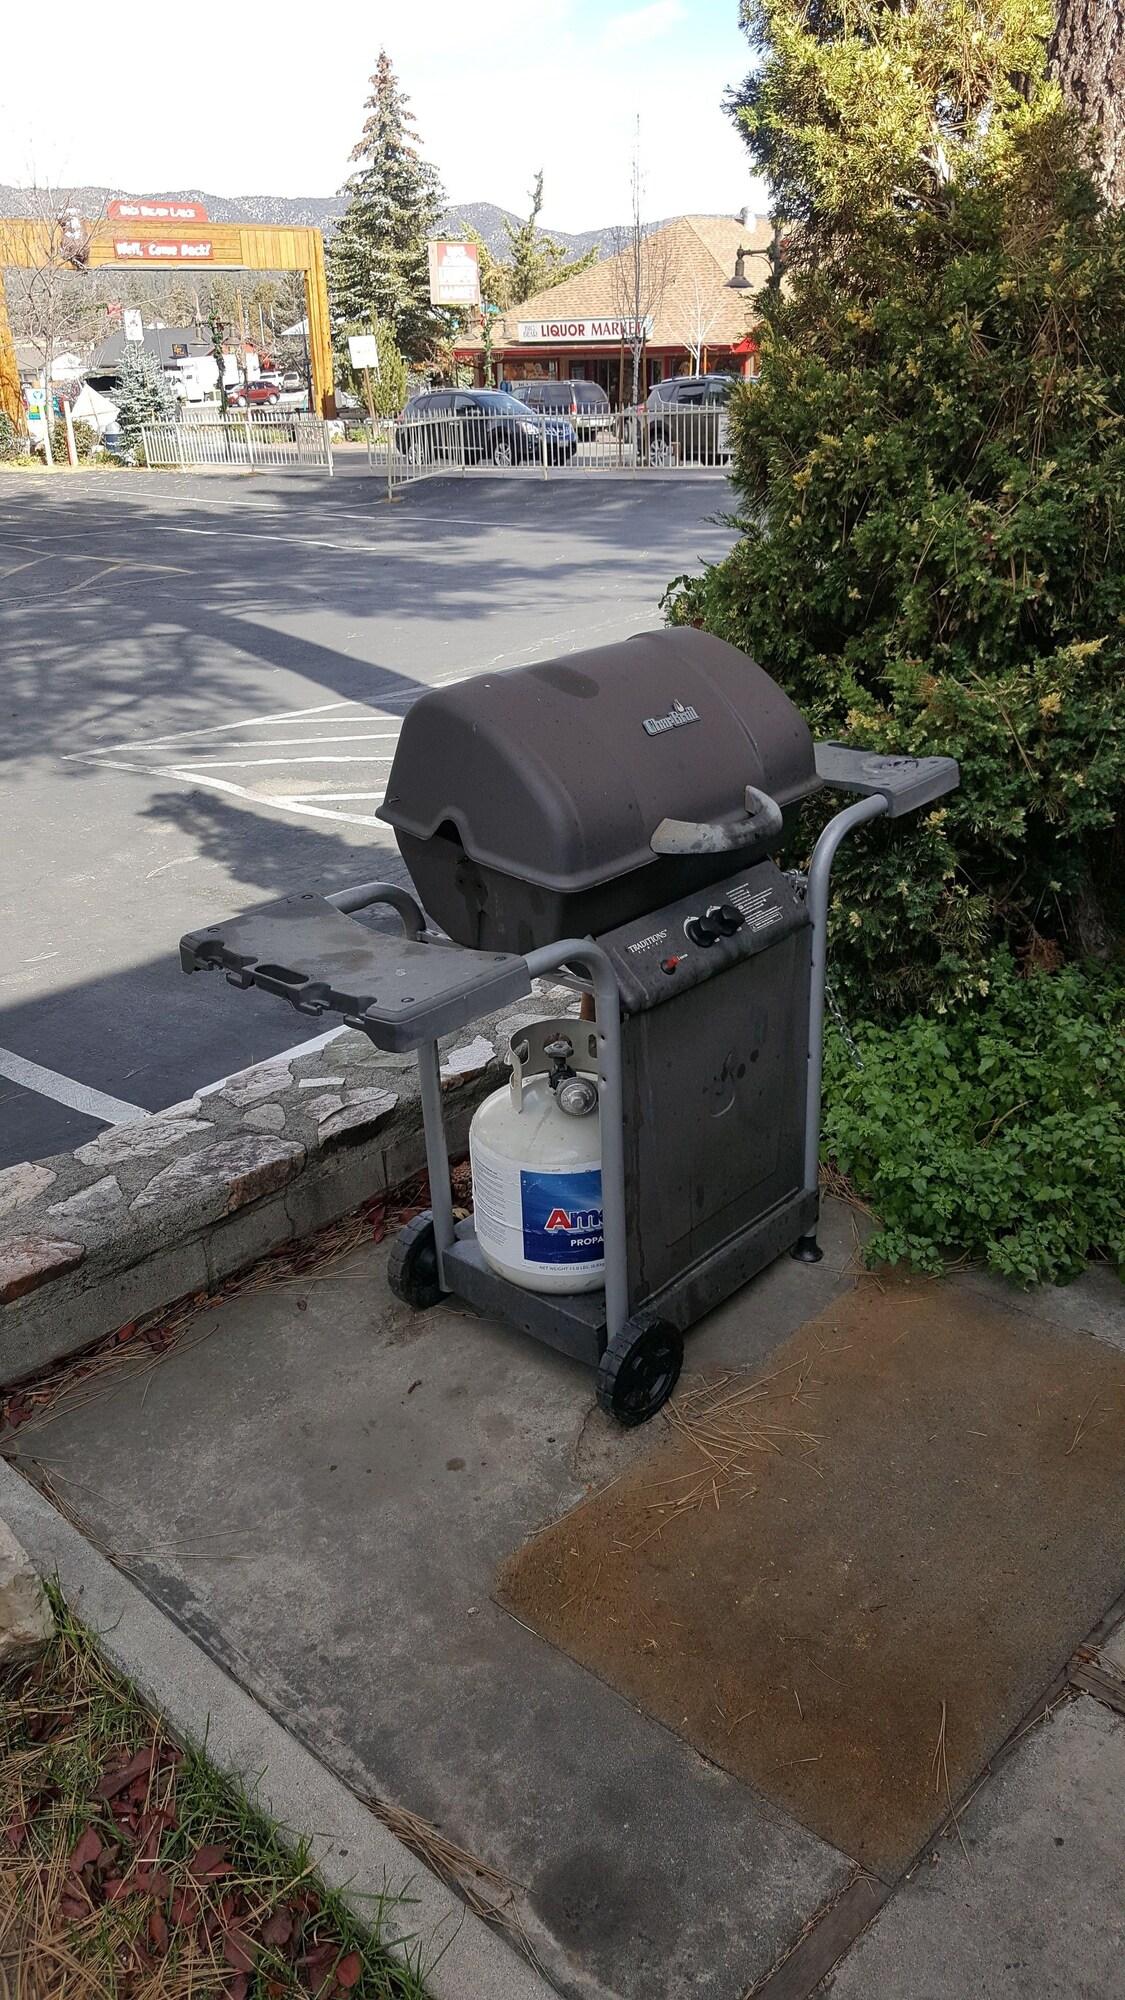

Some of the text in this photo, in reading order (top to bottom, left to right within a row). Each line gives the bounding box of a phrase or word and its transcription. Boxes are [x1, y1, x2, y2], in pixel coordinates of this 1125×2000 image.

[148, 244, 177, 256] Come
[541, 324, 585, 337] LIQUOR
[628, 930, 667, 953] TRADITIONS
